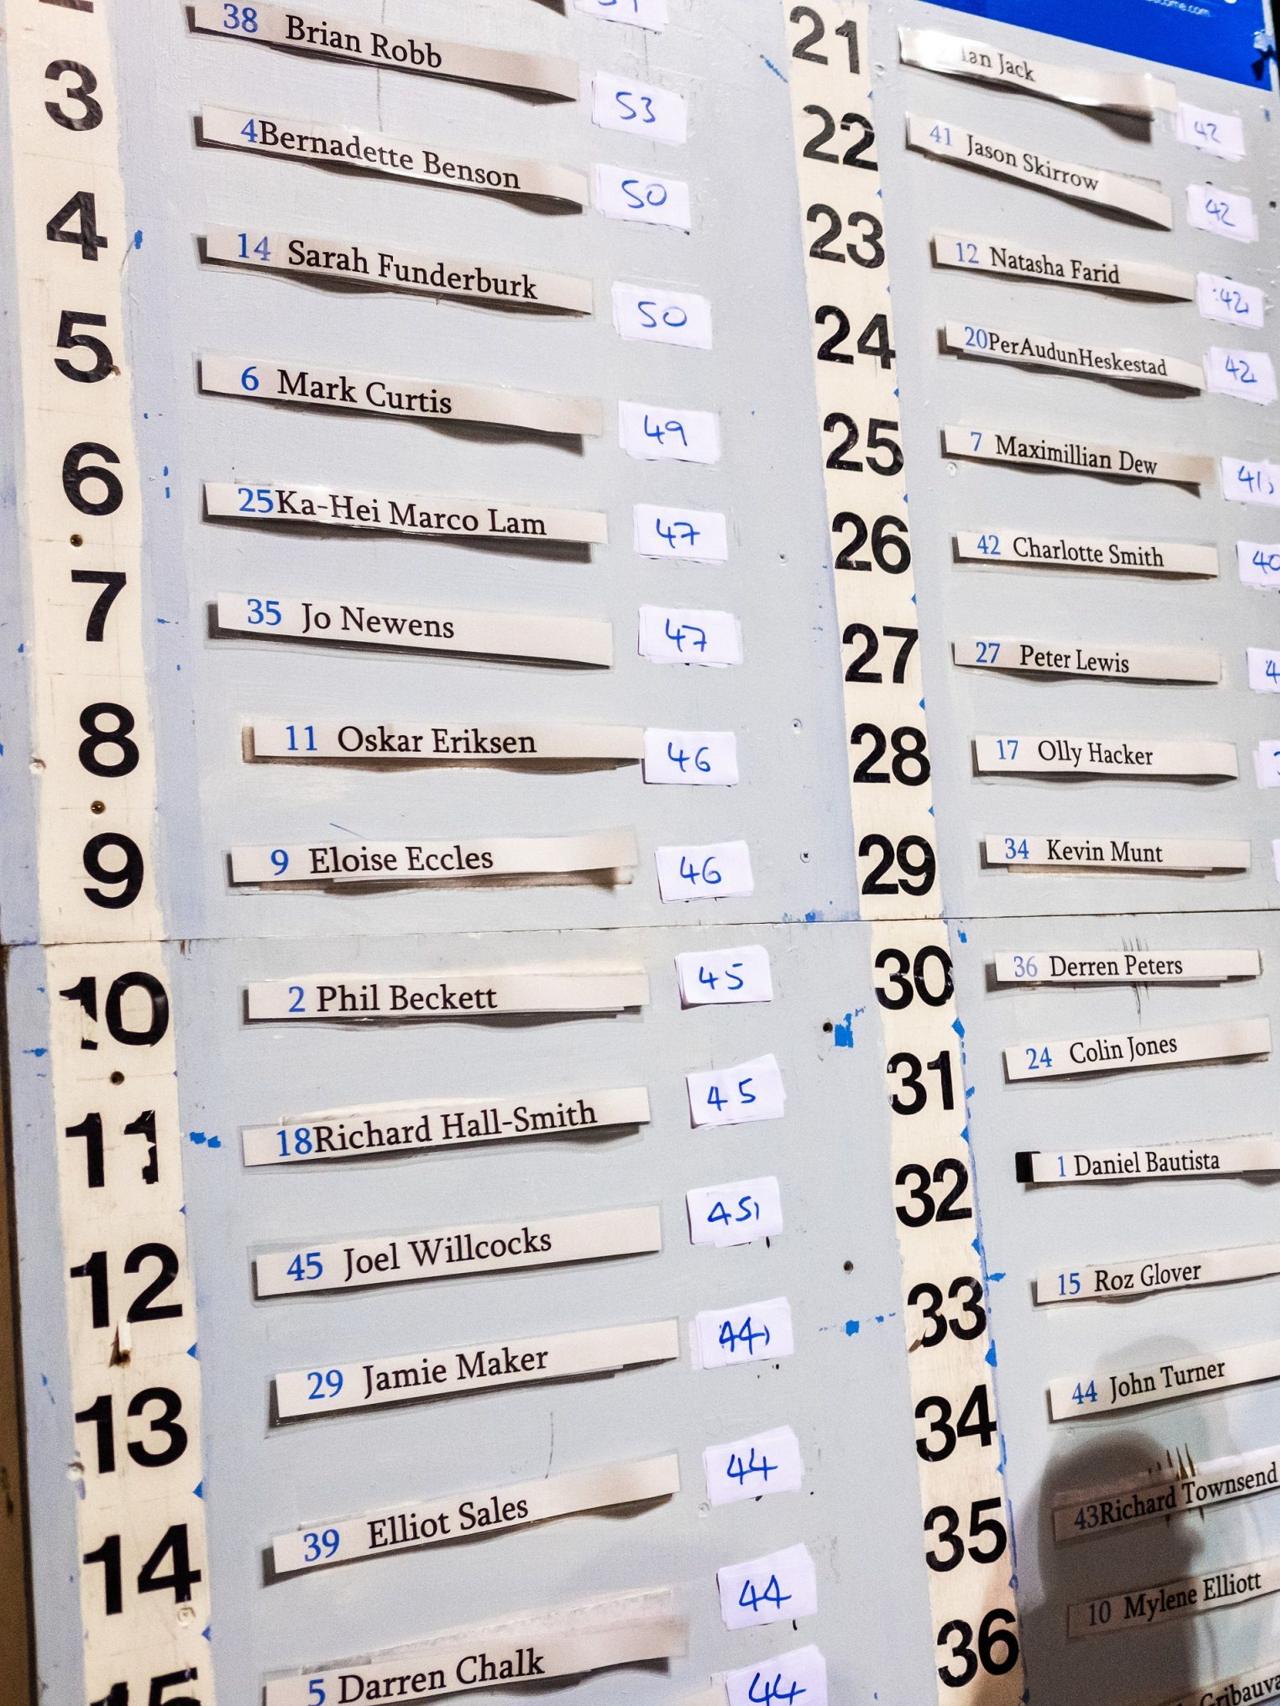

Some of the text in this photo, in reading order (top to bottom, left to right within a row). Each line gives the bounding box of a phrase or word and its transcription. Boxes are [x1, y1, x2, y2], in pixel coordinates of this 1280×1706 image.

[222, 3, 443, 70] 38 Brian Robb
[791, 6, 861, 75] 21
[1000, 52, 1036, 83] Jack
[43, 59, 103, 132] 3
[615, 91, 657, 124] 53
[802, 104, 879, 172] 22
[1195, 120, 1219, 142] 42
[422, 150, 521, 190] Benson
[929, 123, 1099, 191] 41 Jason Skirrow
[621, 178, 668, 208] 50
[1205, 199, 1232, 227] 42
[46, 191, 107, 261] 4
[806, 202, 886, 269] 23
[236, 232, 538, 300] 14 Sarah Funderburk
[955, 241, 1120, 285] 12 Natasha Farid
[639, 301, 687, 327] 50
[1219, 290, 1250, 314] 42
[54, 311, 114, 384] 5
[814, 305, 897, 370] 24
[240, 366, 452, 415] 6 Mark Curtis
[1226, 355, 1258, 385] 42
[643, 415, 686, 447] 49
[821, 412, 905, 477] 25
[970, 431, 1158, 476] 7 Maximillian Dew
[62, 442, 124, 516] 6
[237, 488, 547, 536] 25 Ka-Hei Marco Lam
[654, 519, 700, 547] 47
[831, 511, 912, 574] 26
[977, 534, 1164, 569] 42 Charlotte Smith
[71, 569, 127, 641] 7
[246, 599, 455, 640] 35 Jo Newens
[664, 619, 707, 652] 47
[841, 624, 919, 685] 27
[975, 642, 1130, 674] 27 Peter Lewis
[78, 703, 140, 777] 8
[285, 725, 537, 754] 11 Oskar Eriksen
[668, 744, 712, 772] 46
[849, 723, 931, 787] 28
[996, 739, 1153, 767] 17 Olly Hacker
[83, 833, 144, 909] 9
[269, 845, 494, 876] 9 Eloise Eccles
[678, 855, 723, 884] 46
[857, 834, 936, 897] 29
[1004, 838, 1163, 864] 34 Kevin Munt
[698, 963, 744, 991] 45
[874, 945, 954, 1010] 30
[1013, 954, 1183, 977] 36 Derren Peters
[59, 971, 170, 1051] 10
[288, 981, 498, 1014] 2 Phil Beckett
[1026, 1034, 1177, 1069] 24 Colin Jones
[707, 1078, 758, 1112] 45
[886, 1050, 955, 1115] 31
[442, 1101, 598, 1141] Hall-Smith
[65, 1110, 158, 1188] 11
[1057, 1150, 1220, 1177] 1 Daniel Bautista
[895, 1158, 973, 1228] 32
[286, 1229, 552, 1283] 45 Joel Willcocks
[1057, 1260, 1202, 1296] 15 Roz Glover
[70, 1243, 183, 1329] 12
[907, 1276, 987, 1348] 33
[307, 1348, 549, 1400] 29 Jamie Maker
[1072, 1360, 1225, 1405] 44 John Turner
[76, 1387, 189, 1475] 13
[914, 1384, 998, 1463] 34
[727, 1449, 778, 1483] 44
[1181, 1463, 1279, 1503] Townsend
[303, 1495, 529, 1563] 39 Elliot Sales
[923, 1496, 1008, 1573] 35
[83, 1524, 202, 1616] 14
[739, 1575, 792, 1611] 44
[1088, 1571, 1263, 1627] 10 Mylene Elliott
[937, 1608, 1020, 1688] 36
[308, 1649, 545, 1706] 5 Darren Chalk
[748, 1673, 807, 1704] 44
